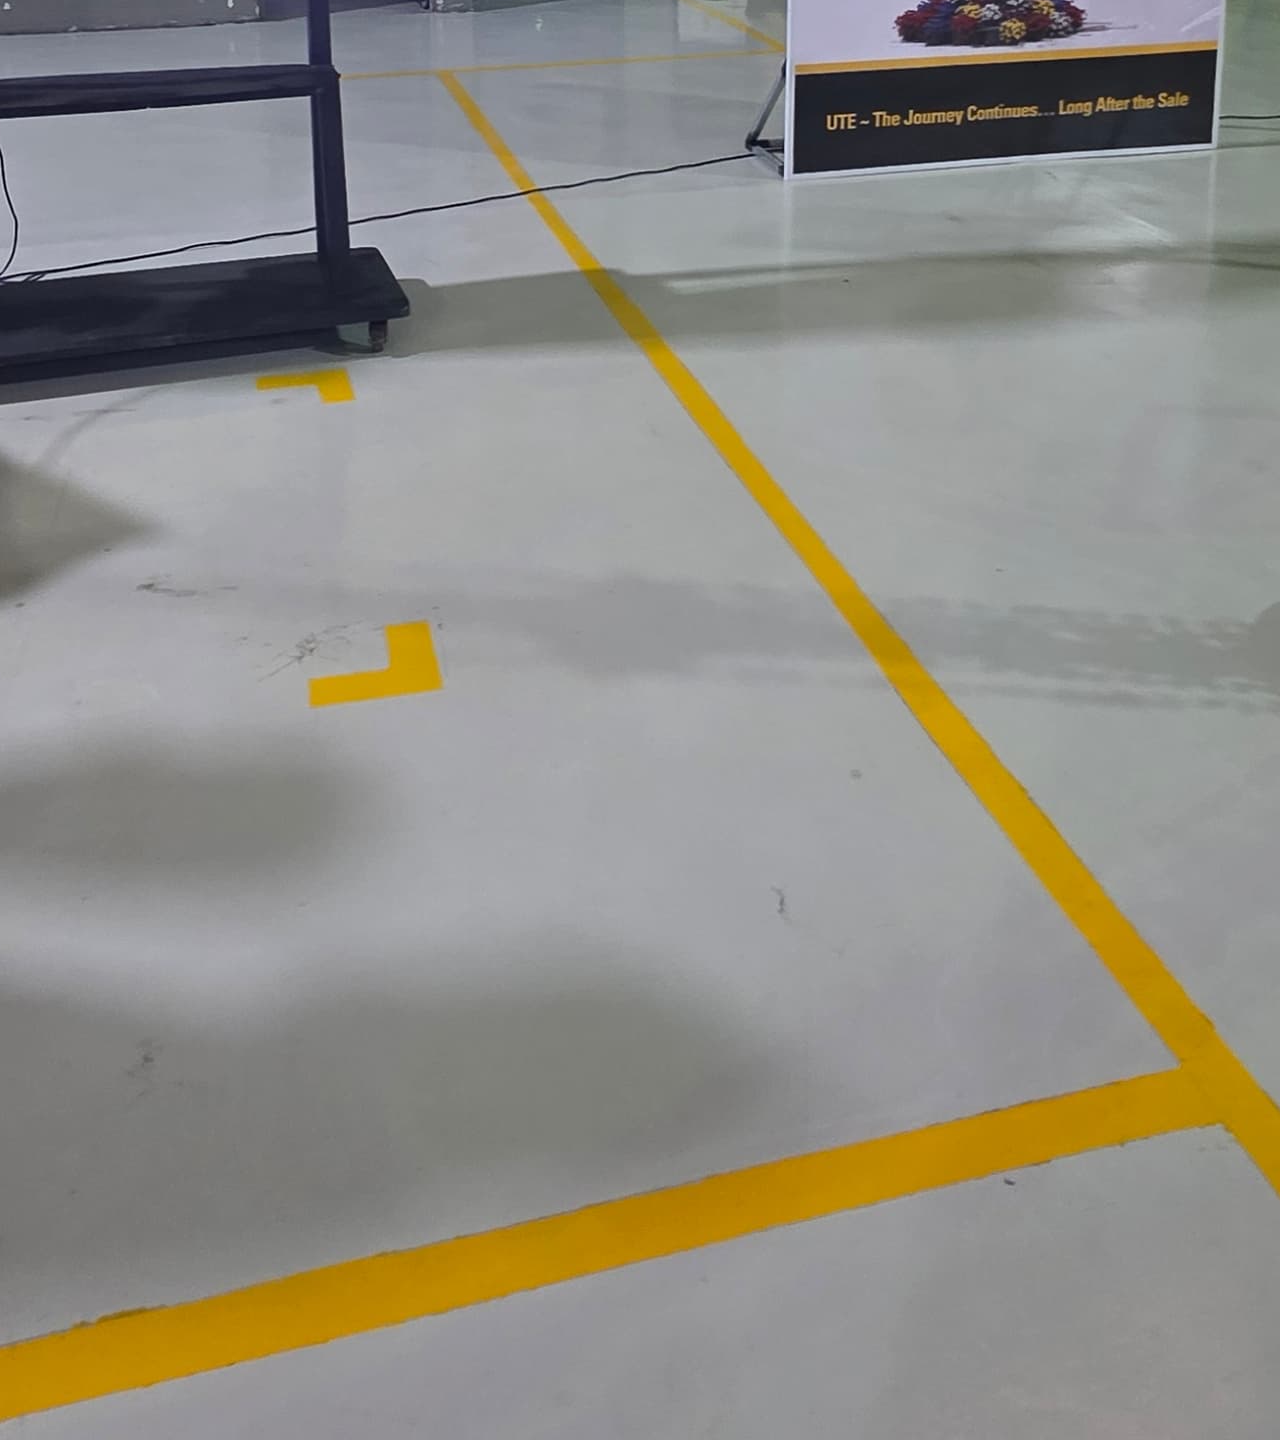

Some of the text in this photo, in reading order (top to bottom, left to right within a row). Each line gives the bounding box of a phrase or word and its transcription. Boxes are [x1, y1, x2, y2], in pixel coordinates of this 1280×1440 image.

[826, 113, 857, 131] UTE
[872, 111, 902, 128] The
[904, 110, 965, 126] Journey
[1058, 100, 1093, 116] Long
[1095, 96, 1131, 113] After
[1132, 94, 1155, 110] the
[1157, 91, 1190, 108] Sale
